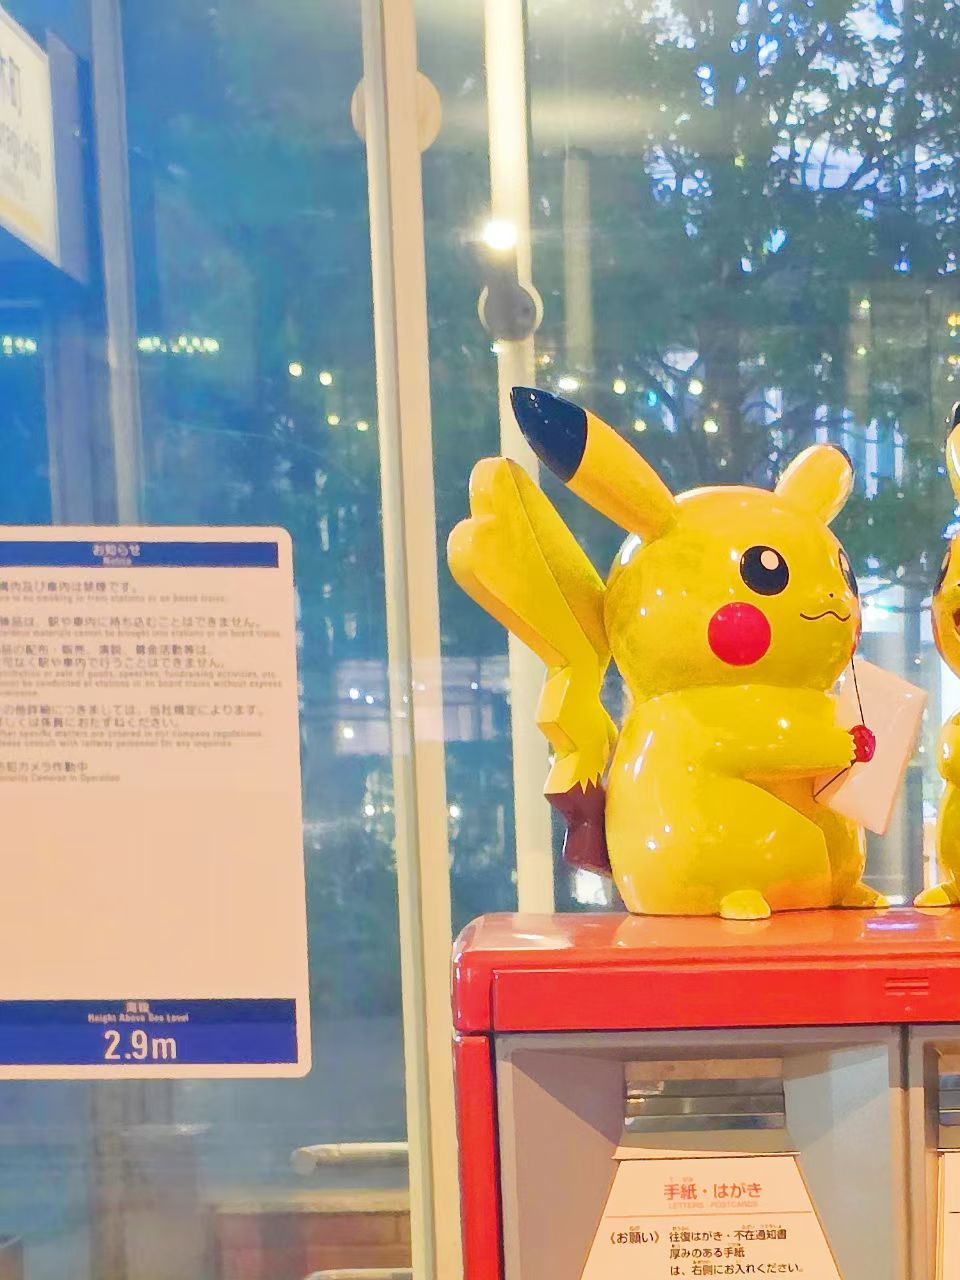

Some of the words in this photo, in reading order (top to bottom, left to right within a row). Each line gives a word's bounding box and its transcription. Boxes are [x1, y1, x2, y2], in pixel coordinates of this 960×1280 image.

[104, 1029, 177, 1060] 2.9m
[664, 1182, 762, 1200] 手紙・はがき
[669, 1247, 745, 1259] 厚みのある手紙
